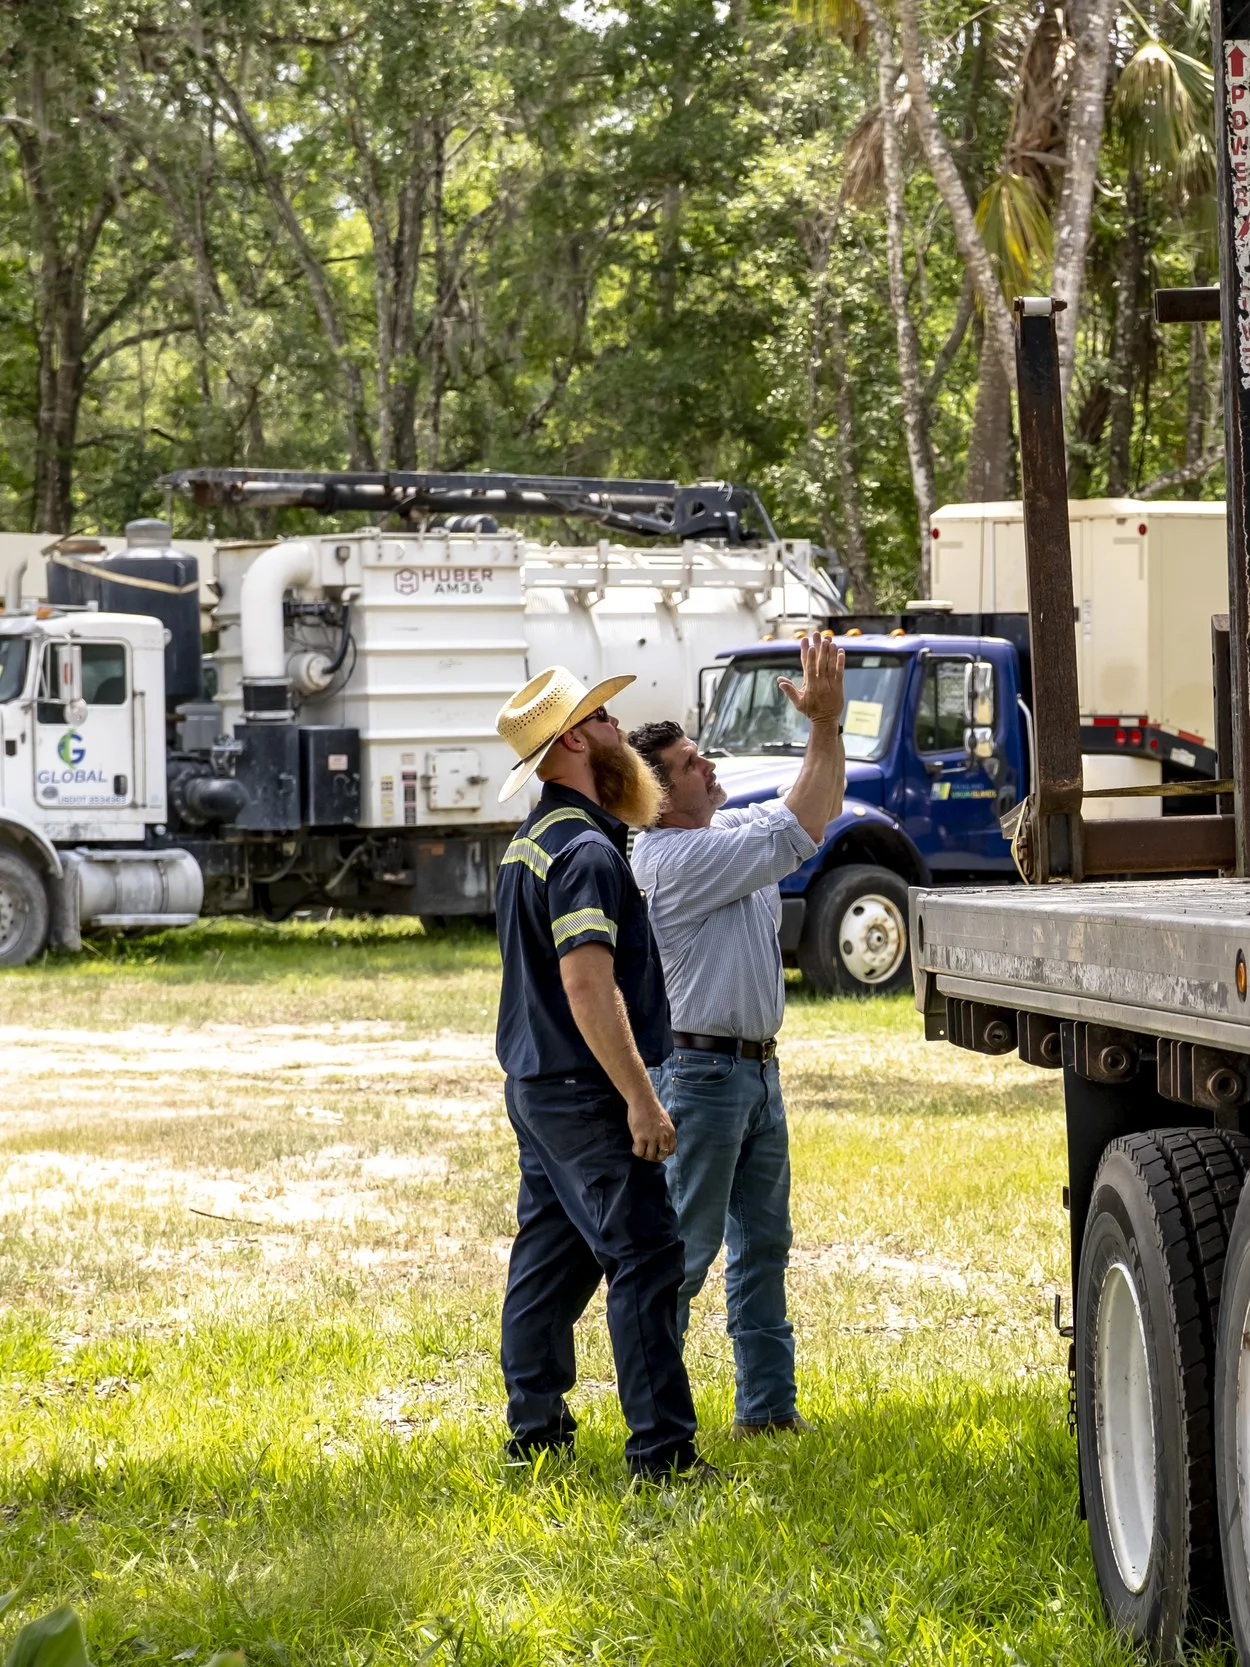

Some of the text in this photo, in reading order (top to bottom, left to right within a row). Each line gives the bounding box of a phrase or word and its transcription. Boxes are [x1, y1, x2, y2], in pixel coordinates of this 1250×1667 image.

[1231, 85, 1249, 207] POWER
[421, 567, 493, 582] HUBER
[434, 583, 483, 594] AM36
[38, 769, 107, 784] GLOBAL
